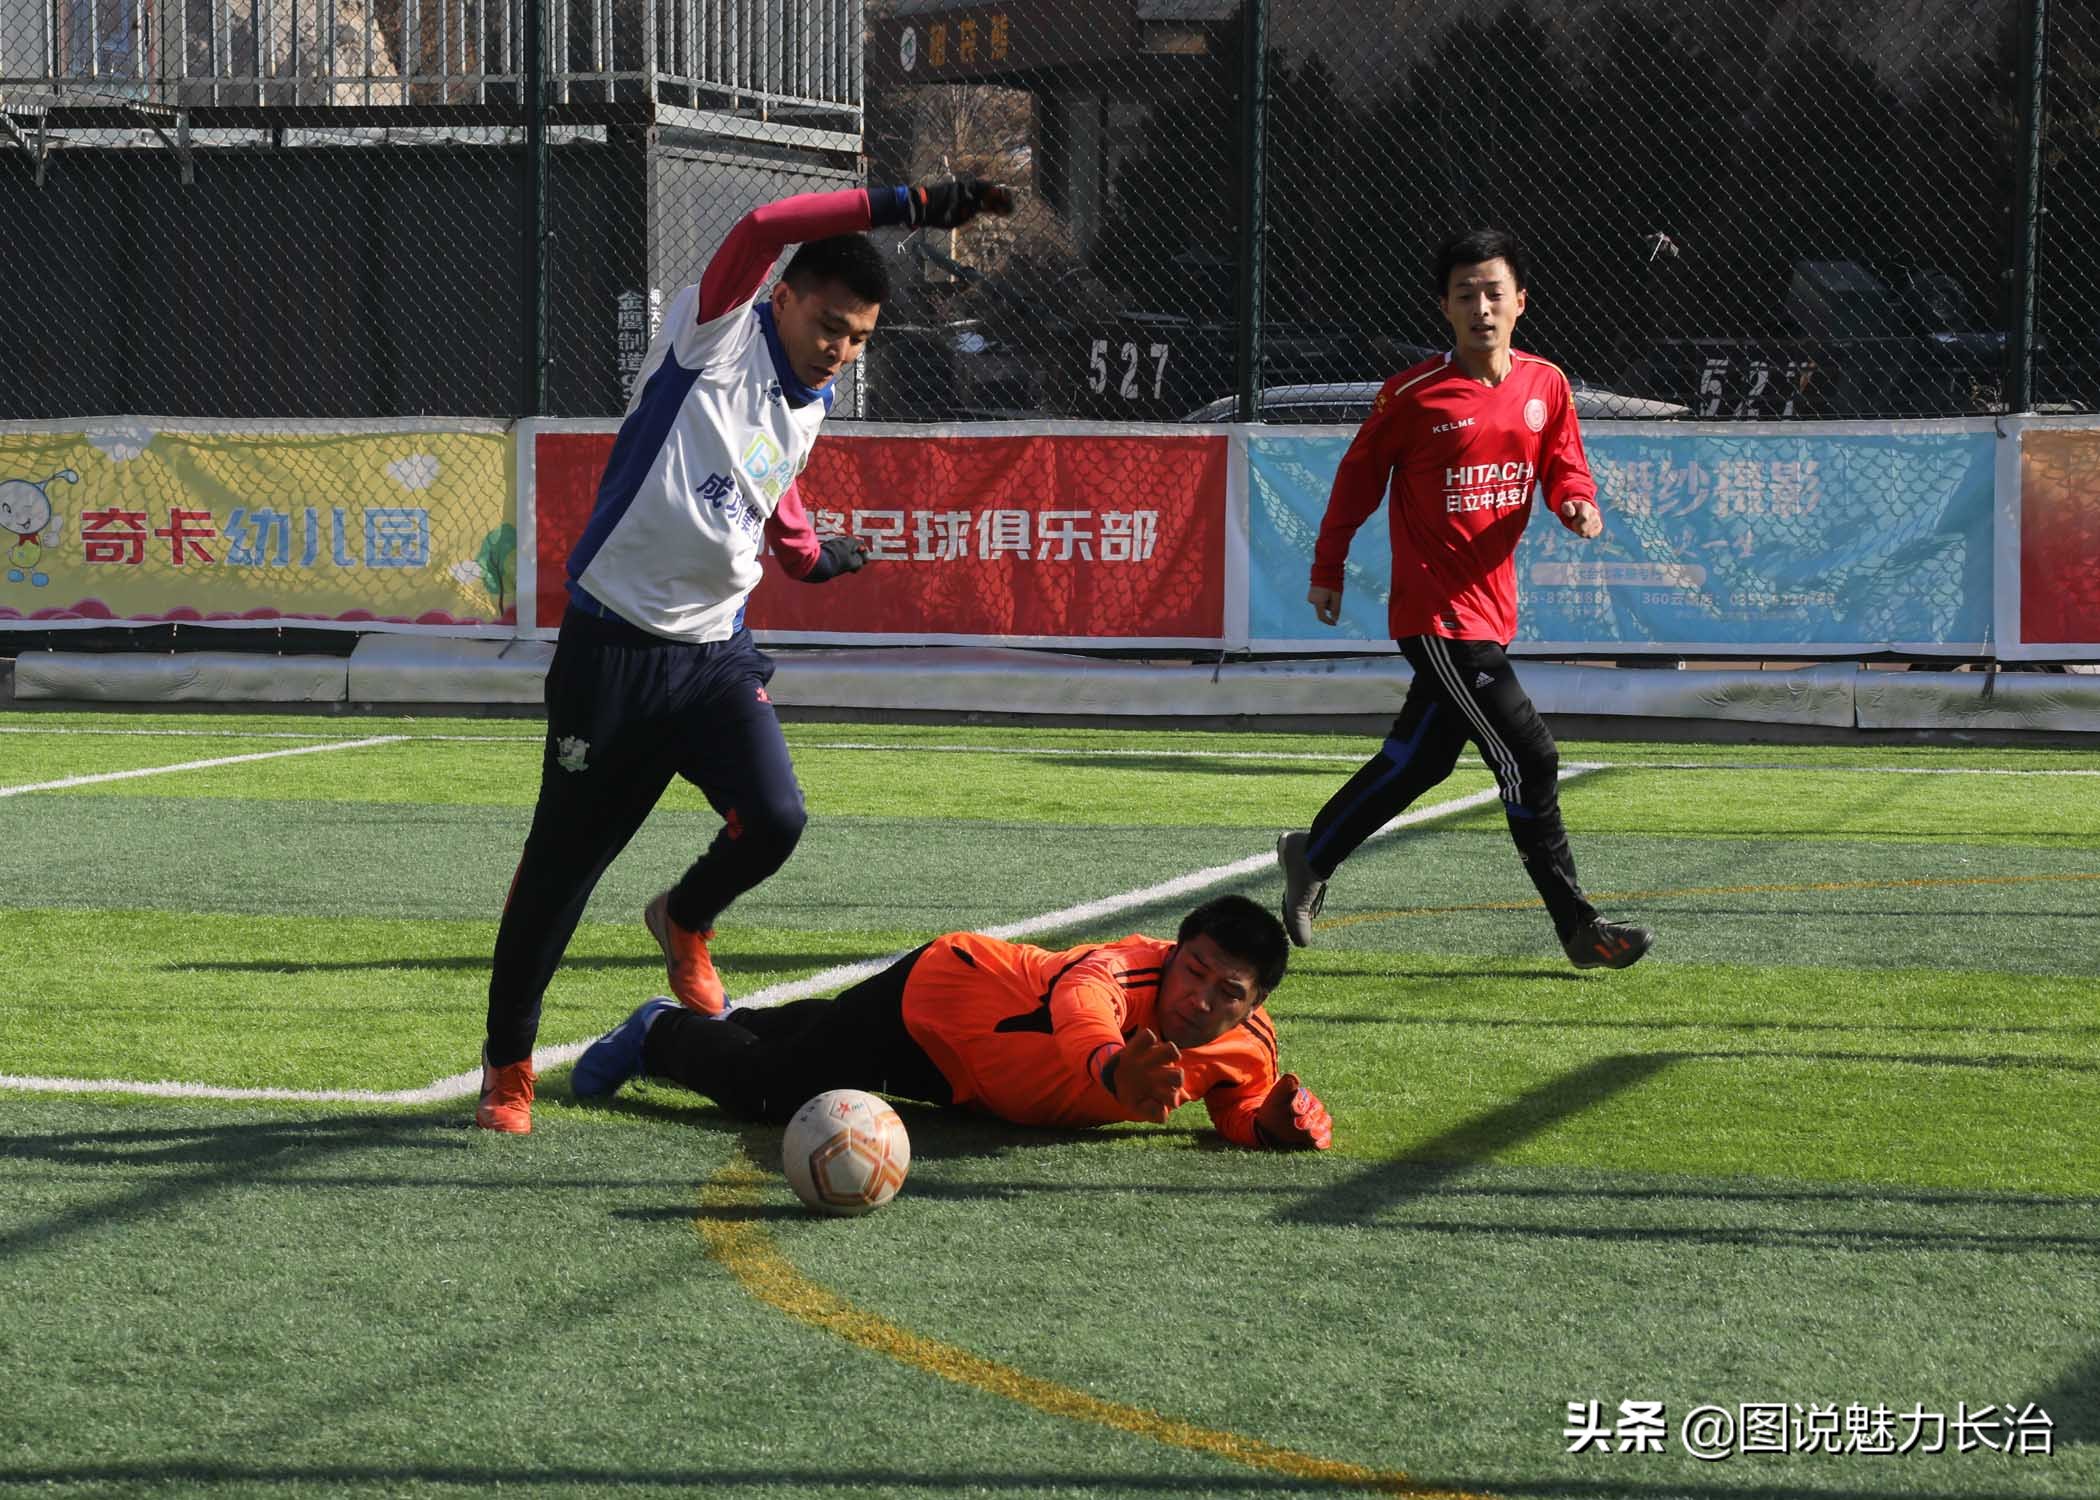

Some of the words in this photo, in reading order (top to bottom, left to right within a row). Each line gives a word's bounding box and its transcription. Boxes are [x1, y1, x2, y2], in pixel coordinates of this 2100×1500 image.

[1088, 338, 1169, 399] 527
[1431, 417, 1476, 435] KELME
[80, 506, 430, 568] 奇卡幼儿园
